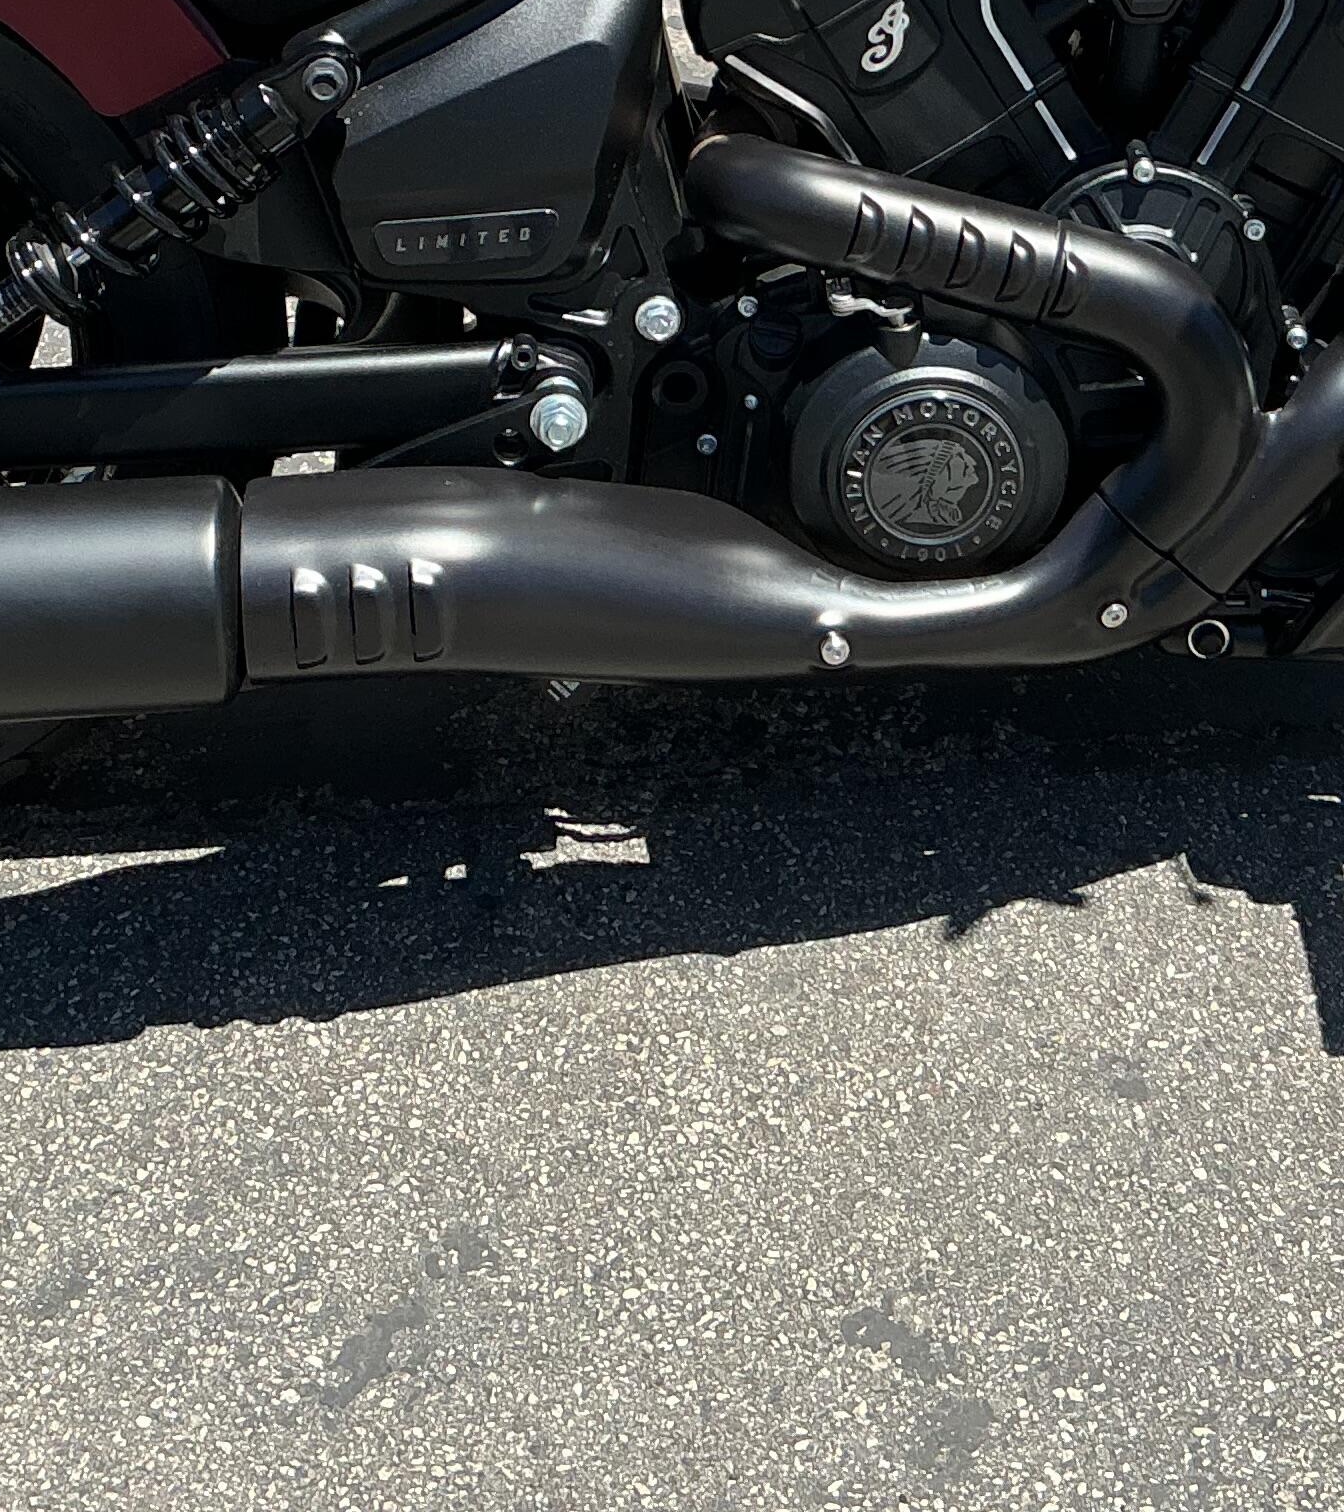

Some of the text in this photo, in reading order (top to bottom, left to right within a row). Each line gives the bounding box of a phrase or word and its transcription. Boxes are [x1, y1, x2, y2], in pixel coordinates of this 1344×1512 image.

[395, 227, 531, 252] LIMITED
[846, 401, 1018, 535] INDIAN MOTORCYCLE
